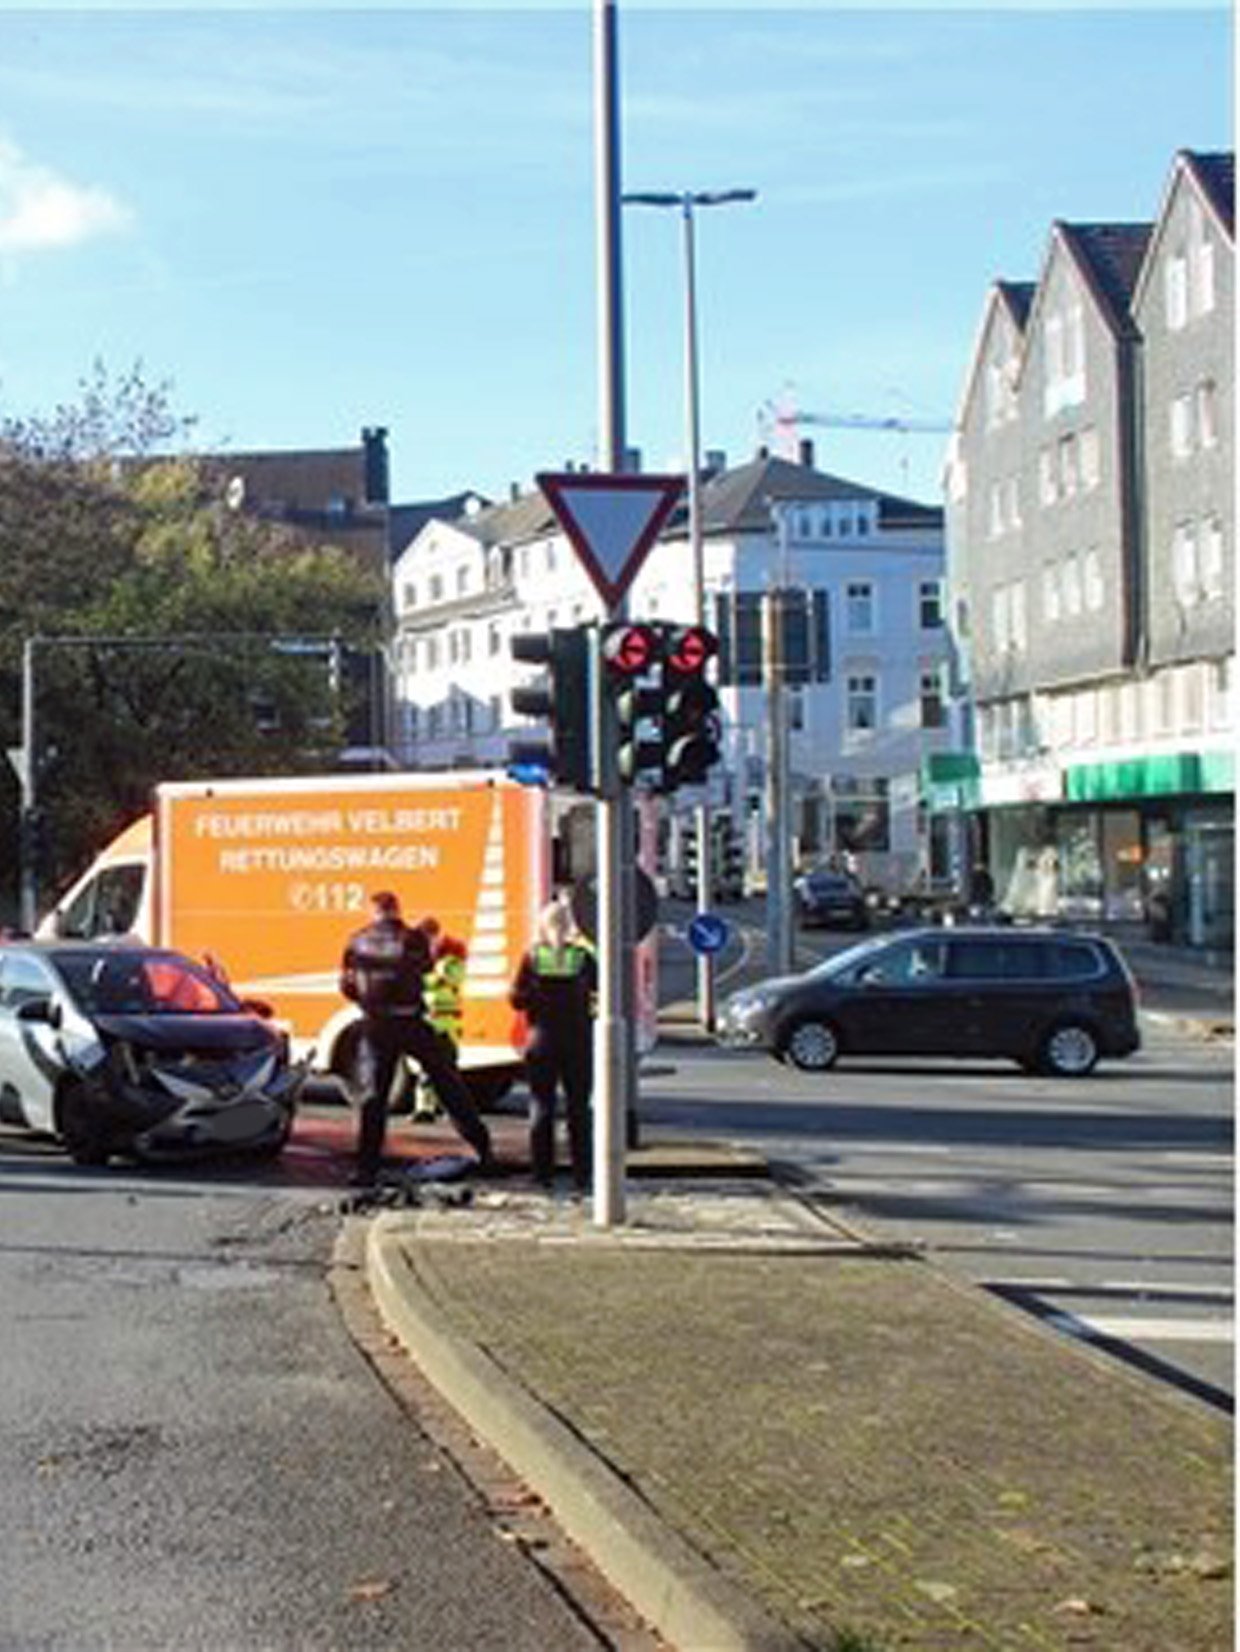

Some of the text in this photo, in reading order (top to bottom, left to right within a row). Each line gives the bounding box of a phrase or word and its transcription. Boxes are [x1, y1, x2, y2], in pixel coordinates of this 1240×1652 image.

[196, 808, 462, 837] FEUERWEHR VELBERT
[219, 846, 440, 873] RETTUNGSWAGEN
